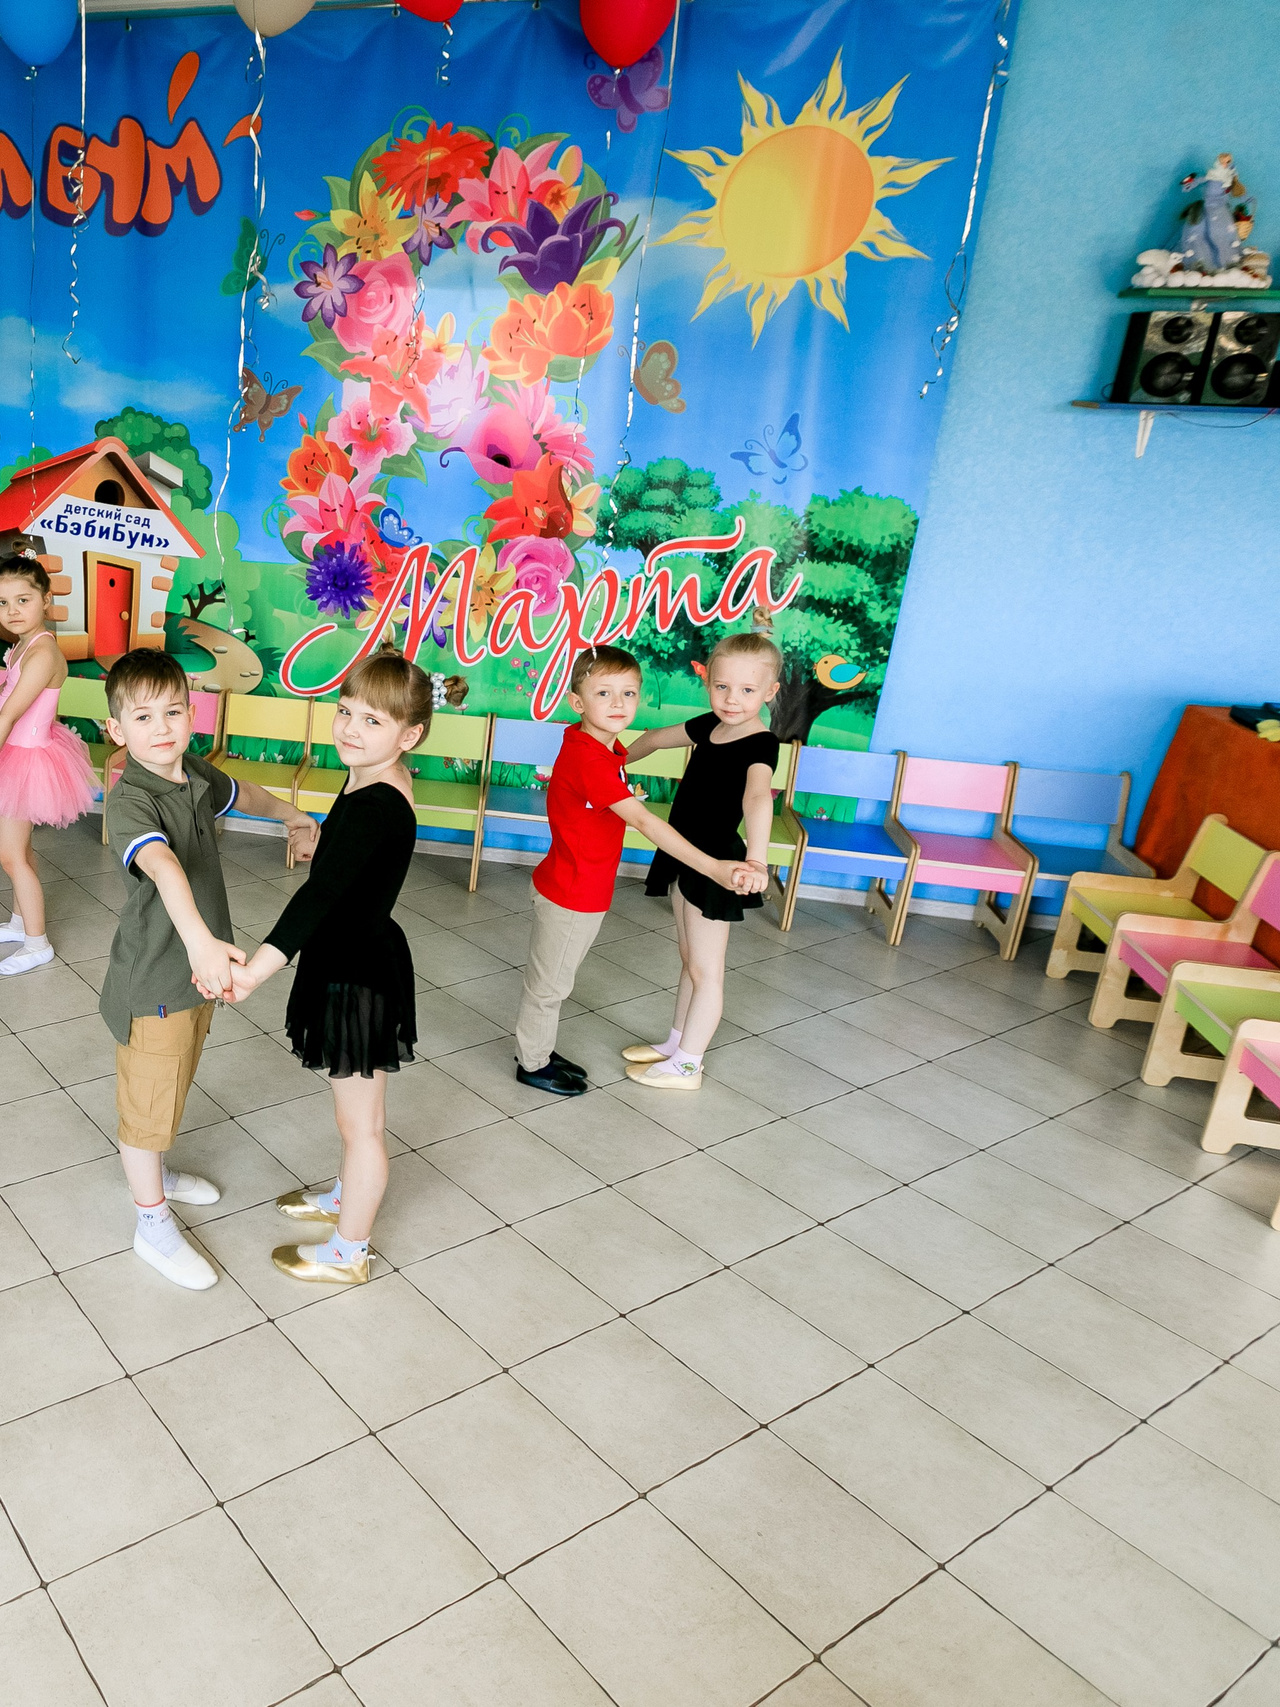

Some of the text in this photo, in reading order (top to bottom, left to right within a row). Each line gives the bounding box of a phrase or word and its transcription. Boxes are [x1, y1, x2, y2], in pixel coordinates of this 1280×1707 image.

[40, 514, 170, 549] «БэбиБум»
[64, 503, 151, 529] детский сад
[279, 515, 802, 721] Марта
